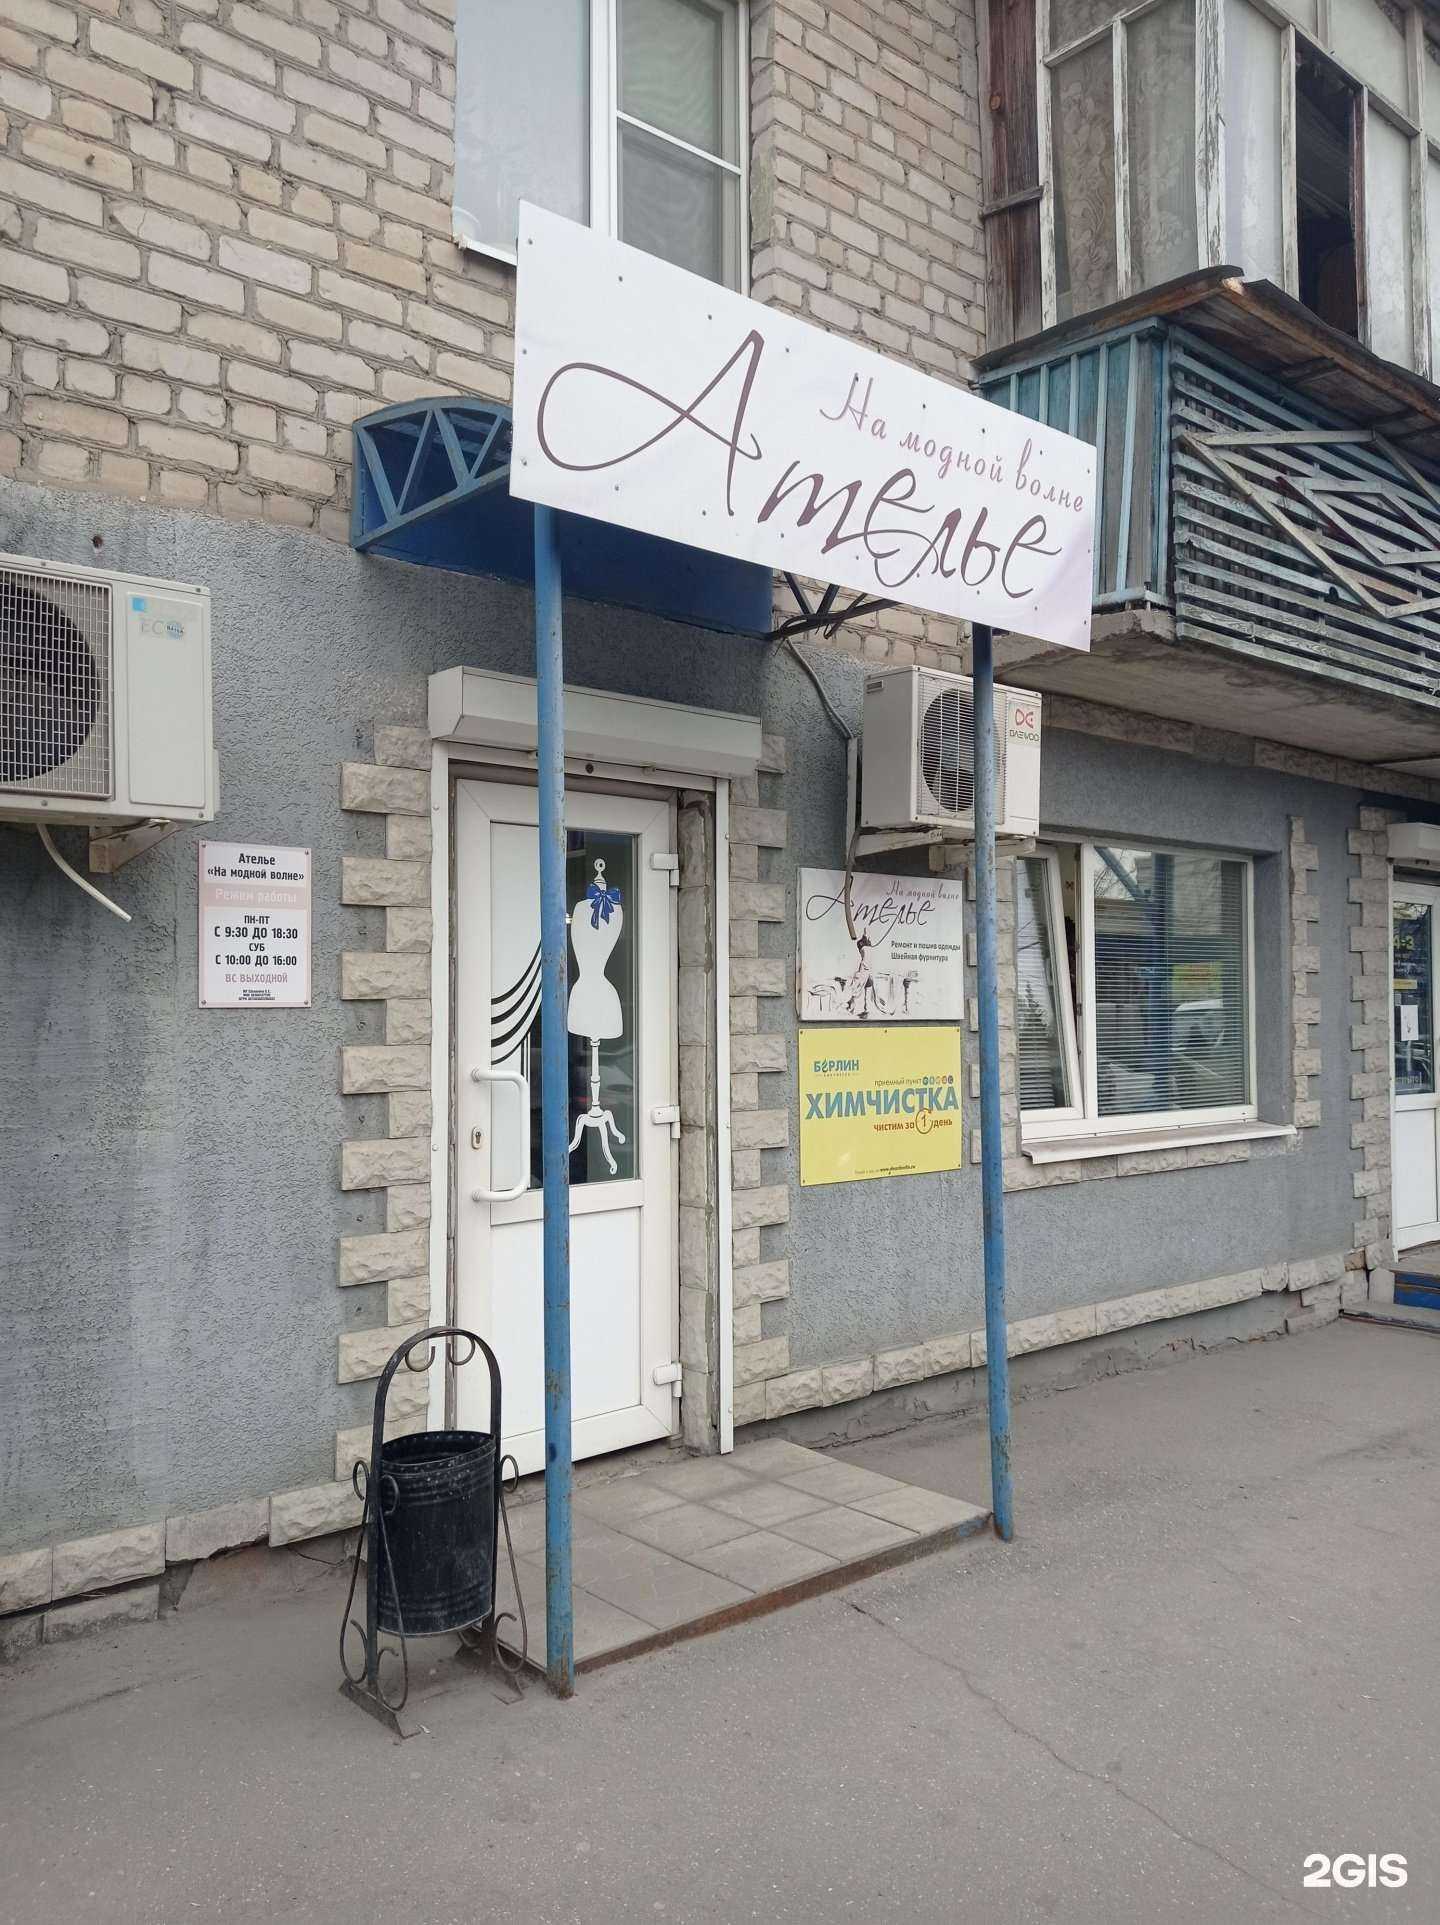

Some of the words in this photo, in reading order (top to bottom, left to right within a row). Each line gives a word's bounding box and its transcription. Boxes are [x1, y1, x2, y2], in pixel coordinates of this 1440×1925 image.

[819, 372, 886, 442] На
[900, 430, 1004, 483] модной
[1016, 438, 1085, 513] волне
[537, 329, 1063, 599] Ателье
[1009, 730, 1040, 741] DAEWOO
[238, 852, 276, 866] Ателье
[207, 866, 227, 877] «На
[230, 869, 267, 880] модной
[270, 871, 305, 881] волне»
[806, 876, 935, 930] Ателье
[244, 915, 270, 925] ПН-ПТ
[214, 926, 221, 938] С
[225, 927, 249, 938] 9:30
[252, 927, 267, 940] ДО
[272, 928, 298, 939] 18:30
[248, 943, 265, 952] СУБ
[891, 940, 913, 949] Ремонт
[215, 955, 221, 965] С
[225, 955, 251, 965] 10:00
[254, 955, 269, 967] ДО
[272, 956, 297, 966] 16:00
[225, 973, 237, 983] ВС
[240, 972, 288, 984] ВЫХОДНОЙ
[805, 1086, 960, 1120] ХИМЧИСТКА
[873, 1122, 904, 1132] чистим
[904, 1121, 915, 1130] за
[933, 1119, 953, 1129] день
